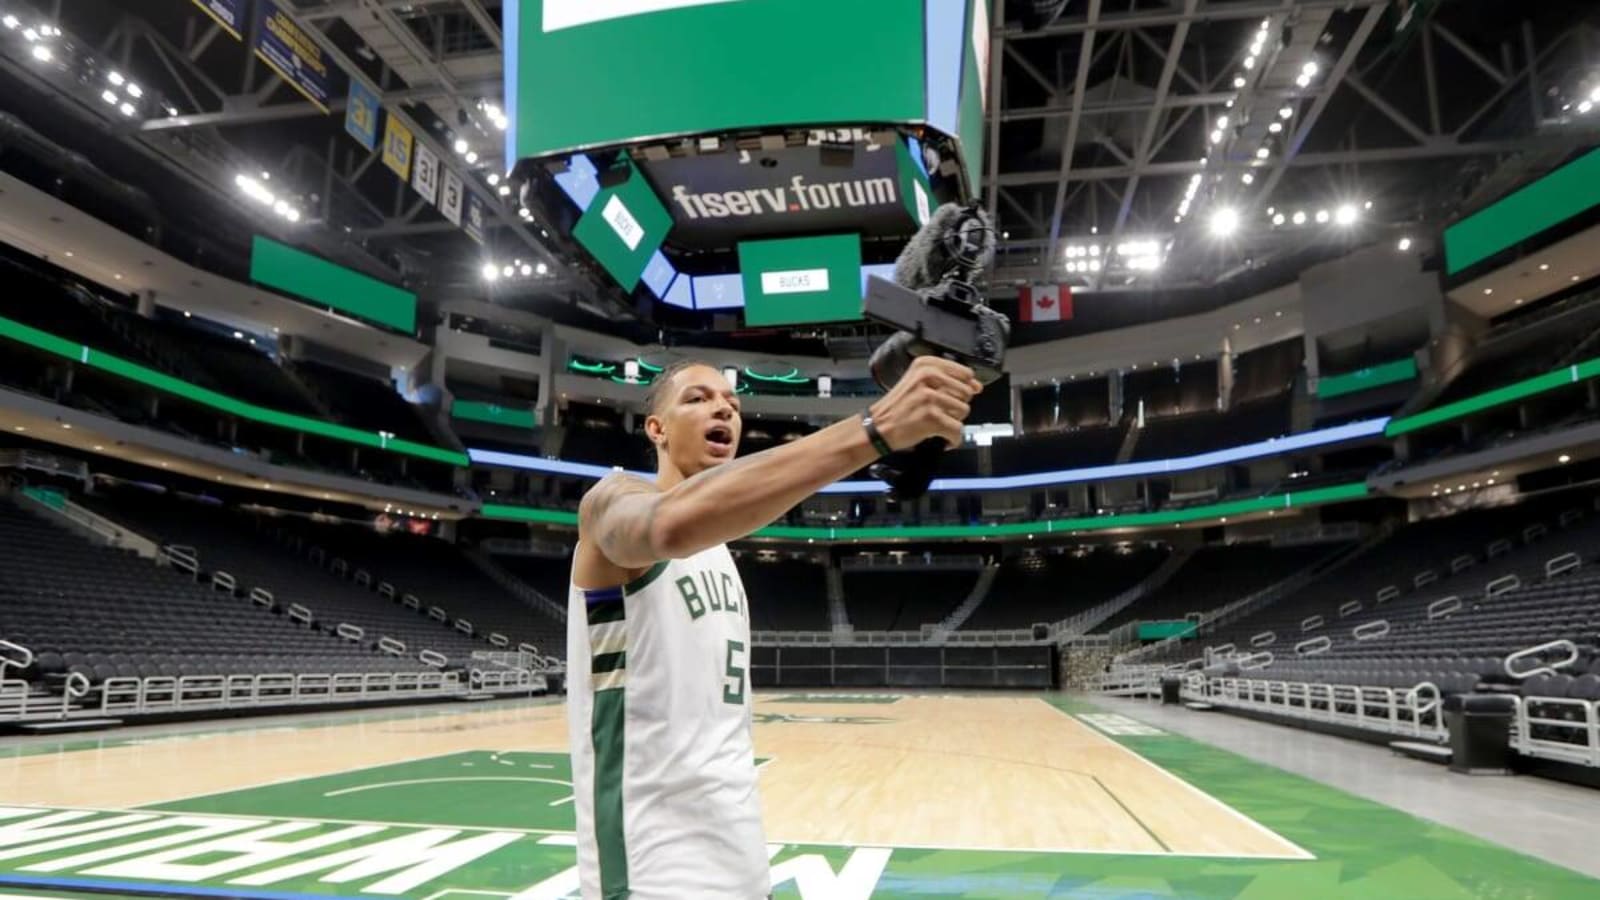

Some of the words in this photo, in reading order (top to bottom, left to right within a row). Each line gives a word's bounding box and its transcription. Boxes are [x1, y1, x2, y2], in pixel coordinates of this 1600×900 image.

[419, 159, 434, 189] 31
[448, 184, 457, 209] 3
[779, 275, 811, 288] BUCKS
[723, 639, 745, 705] 5
